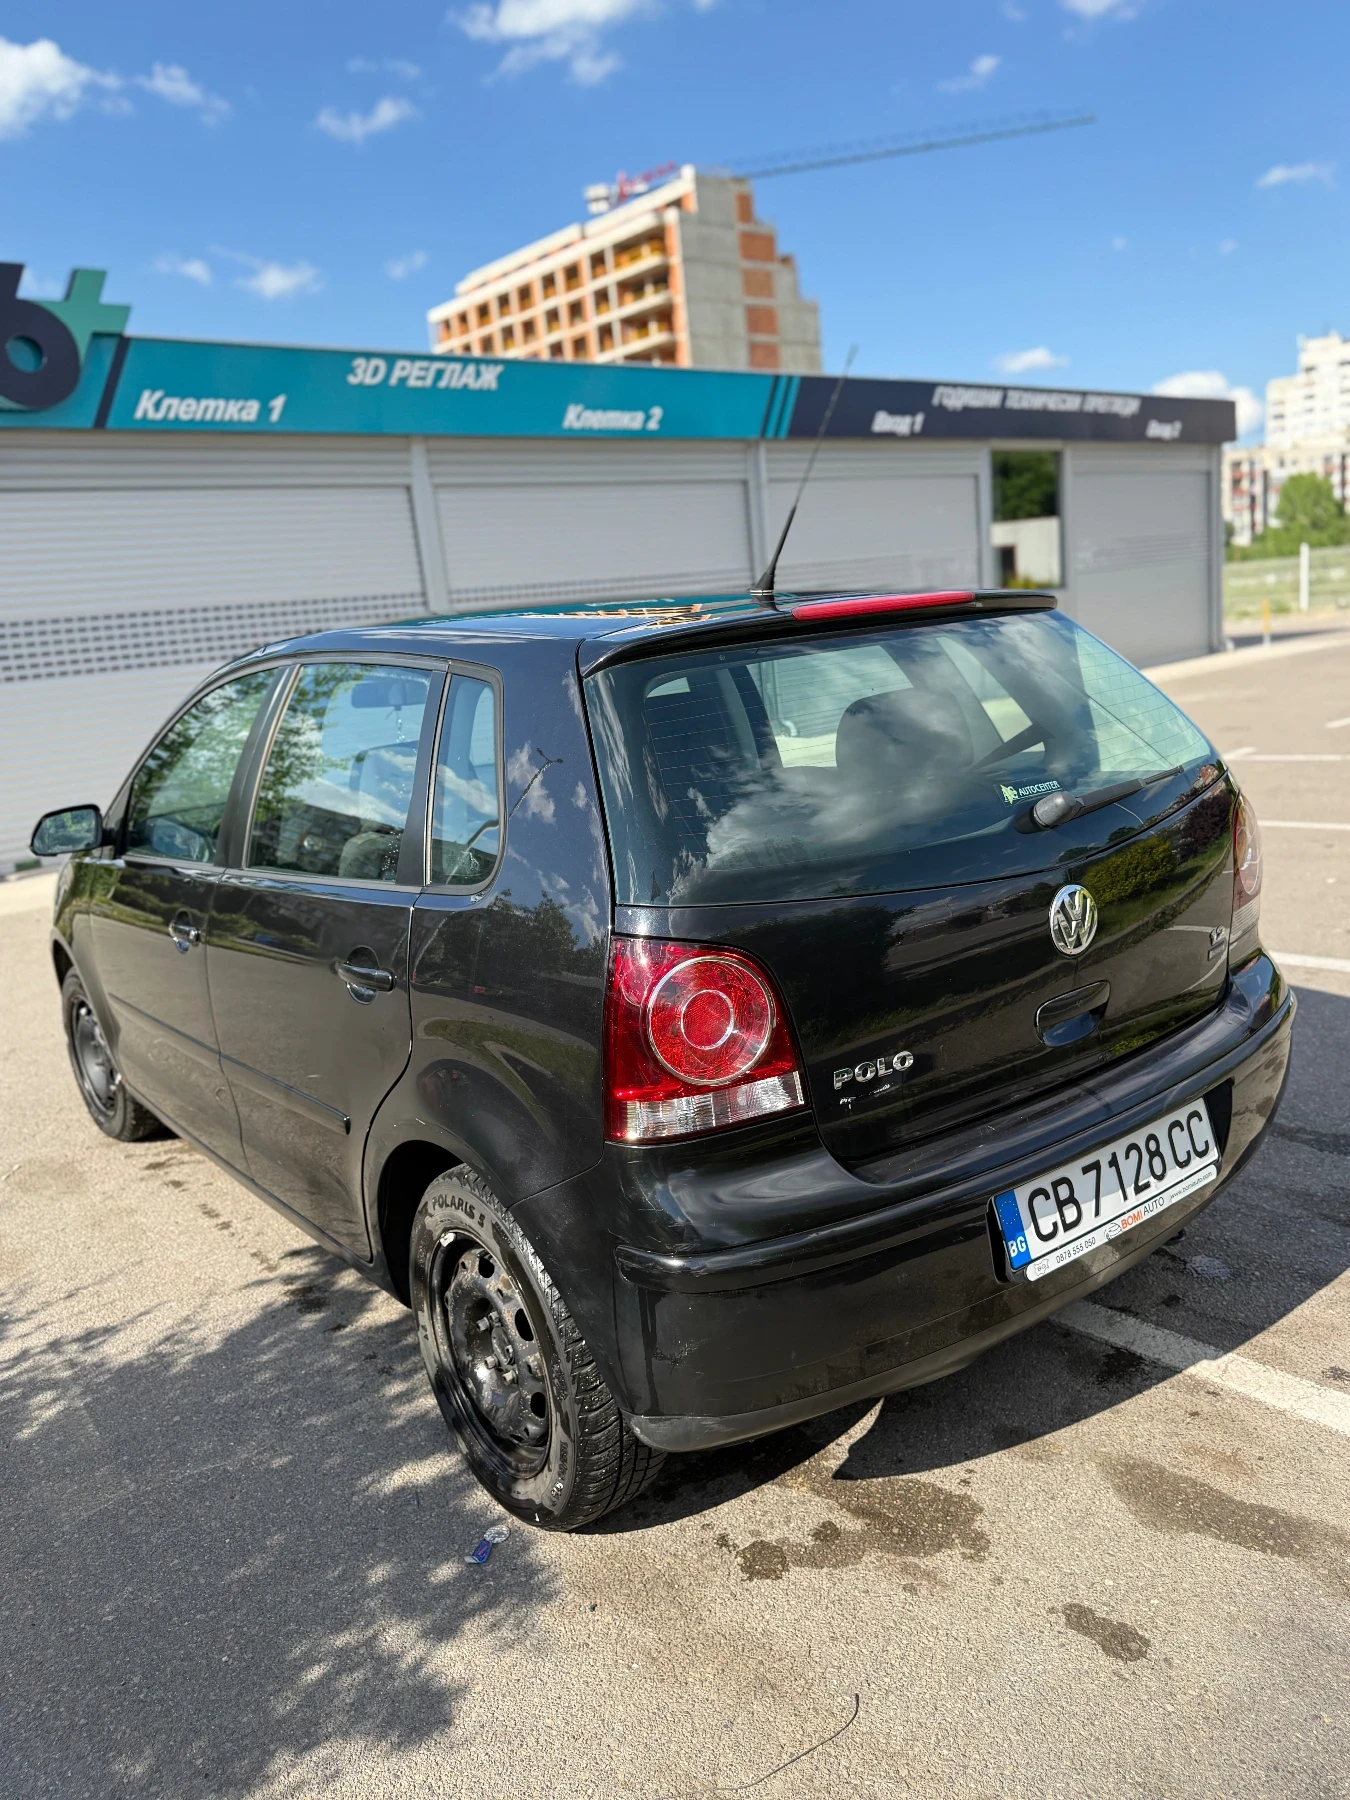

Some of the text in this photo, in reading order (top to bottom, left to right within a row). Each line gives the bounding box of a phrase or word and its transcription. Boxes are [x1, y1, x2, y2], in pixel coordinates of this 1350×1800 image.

[390, 359, 505, 391] РЕГЛАЖ
[134, 389, 288, 423] Клетка 1
[562, 404, 664, 431] Клетка 2
[1018, 780, 1061, 797] AUTOCENTER
[833, 1050, 915, 1090] POLO
[432, 1194, 475, 1219] POLARIS
[1120, 1196, 1165, 1229] BOMI AUTO
[1008, 1236, 1027, 1257] BG
[1056, 1237, 1097, 1264] 0878 555 050
